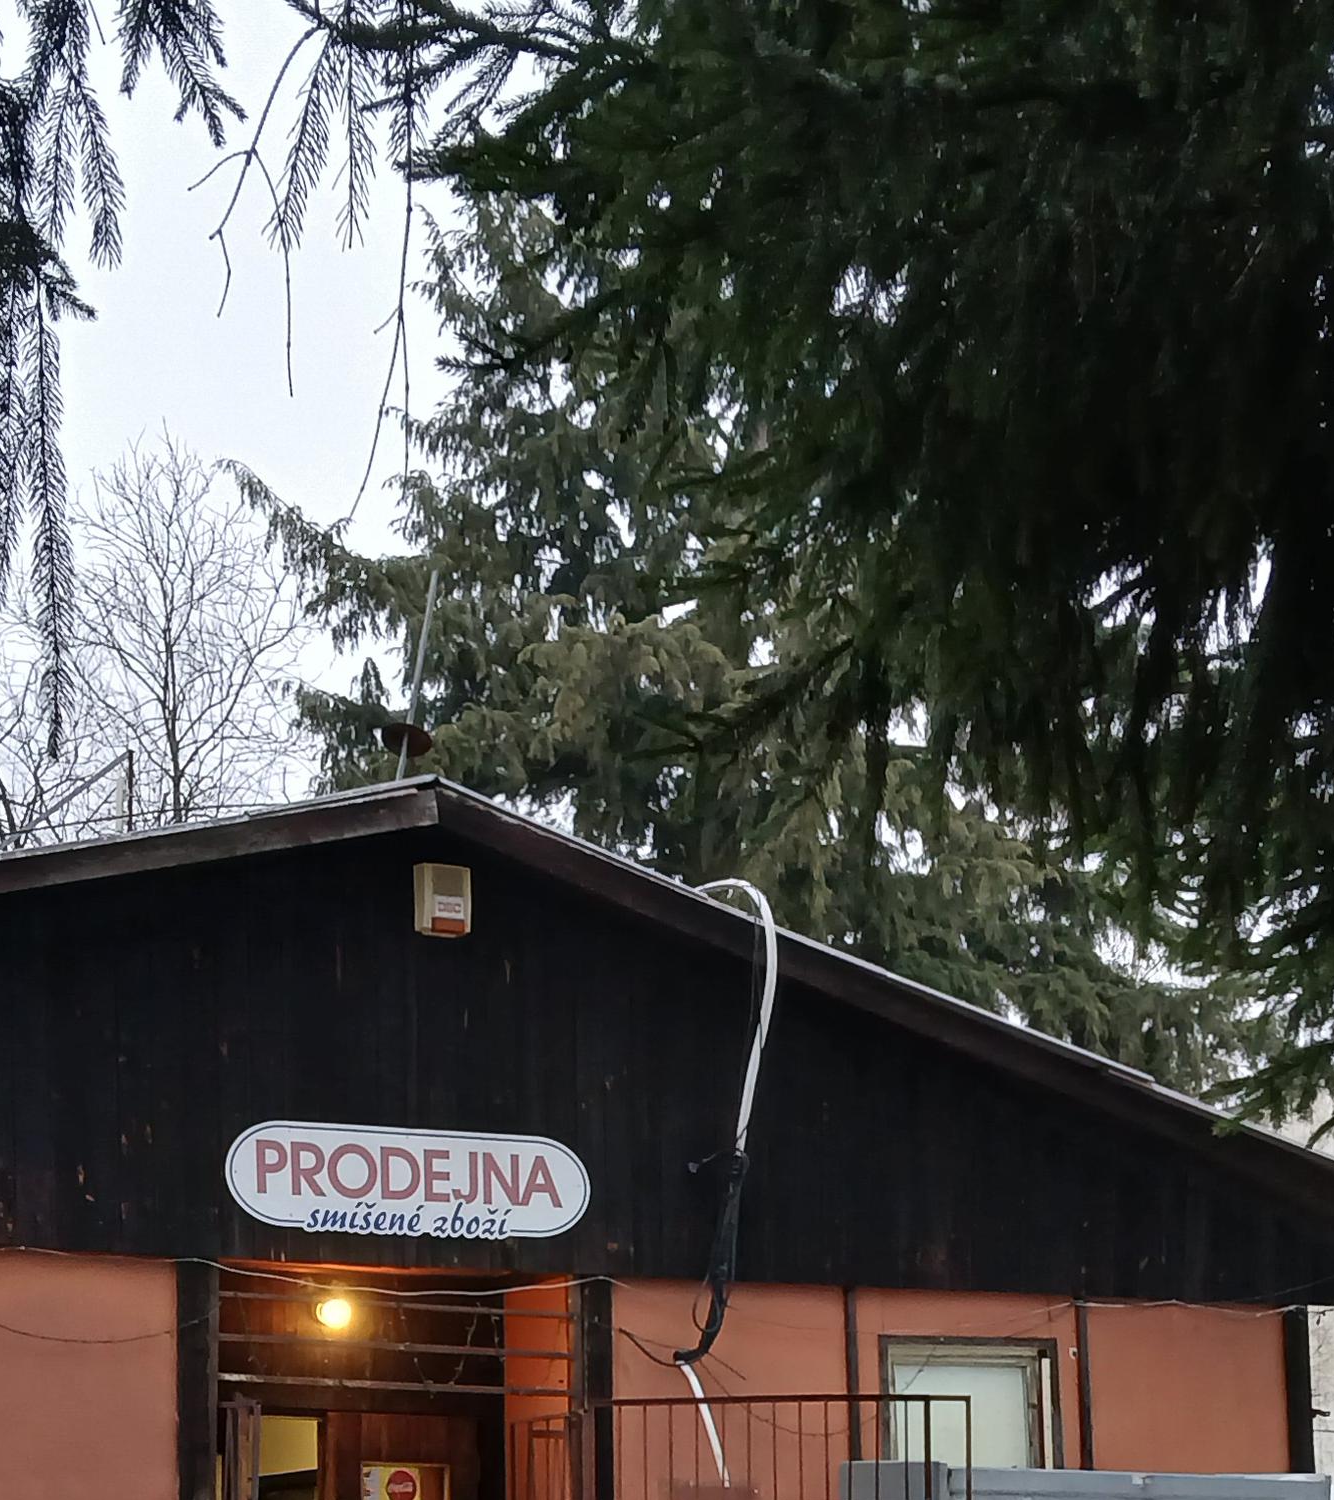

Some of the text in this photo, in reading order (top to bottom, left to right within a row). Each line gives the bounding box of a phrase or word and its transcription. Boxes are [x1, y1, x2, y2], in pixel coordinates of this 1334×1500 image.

[255, 1139, 563, 1208] PRODEJNA
[306, 1201, 511, 1236] smíšené zboží
